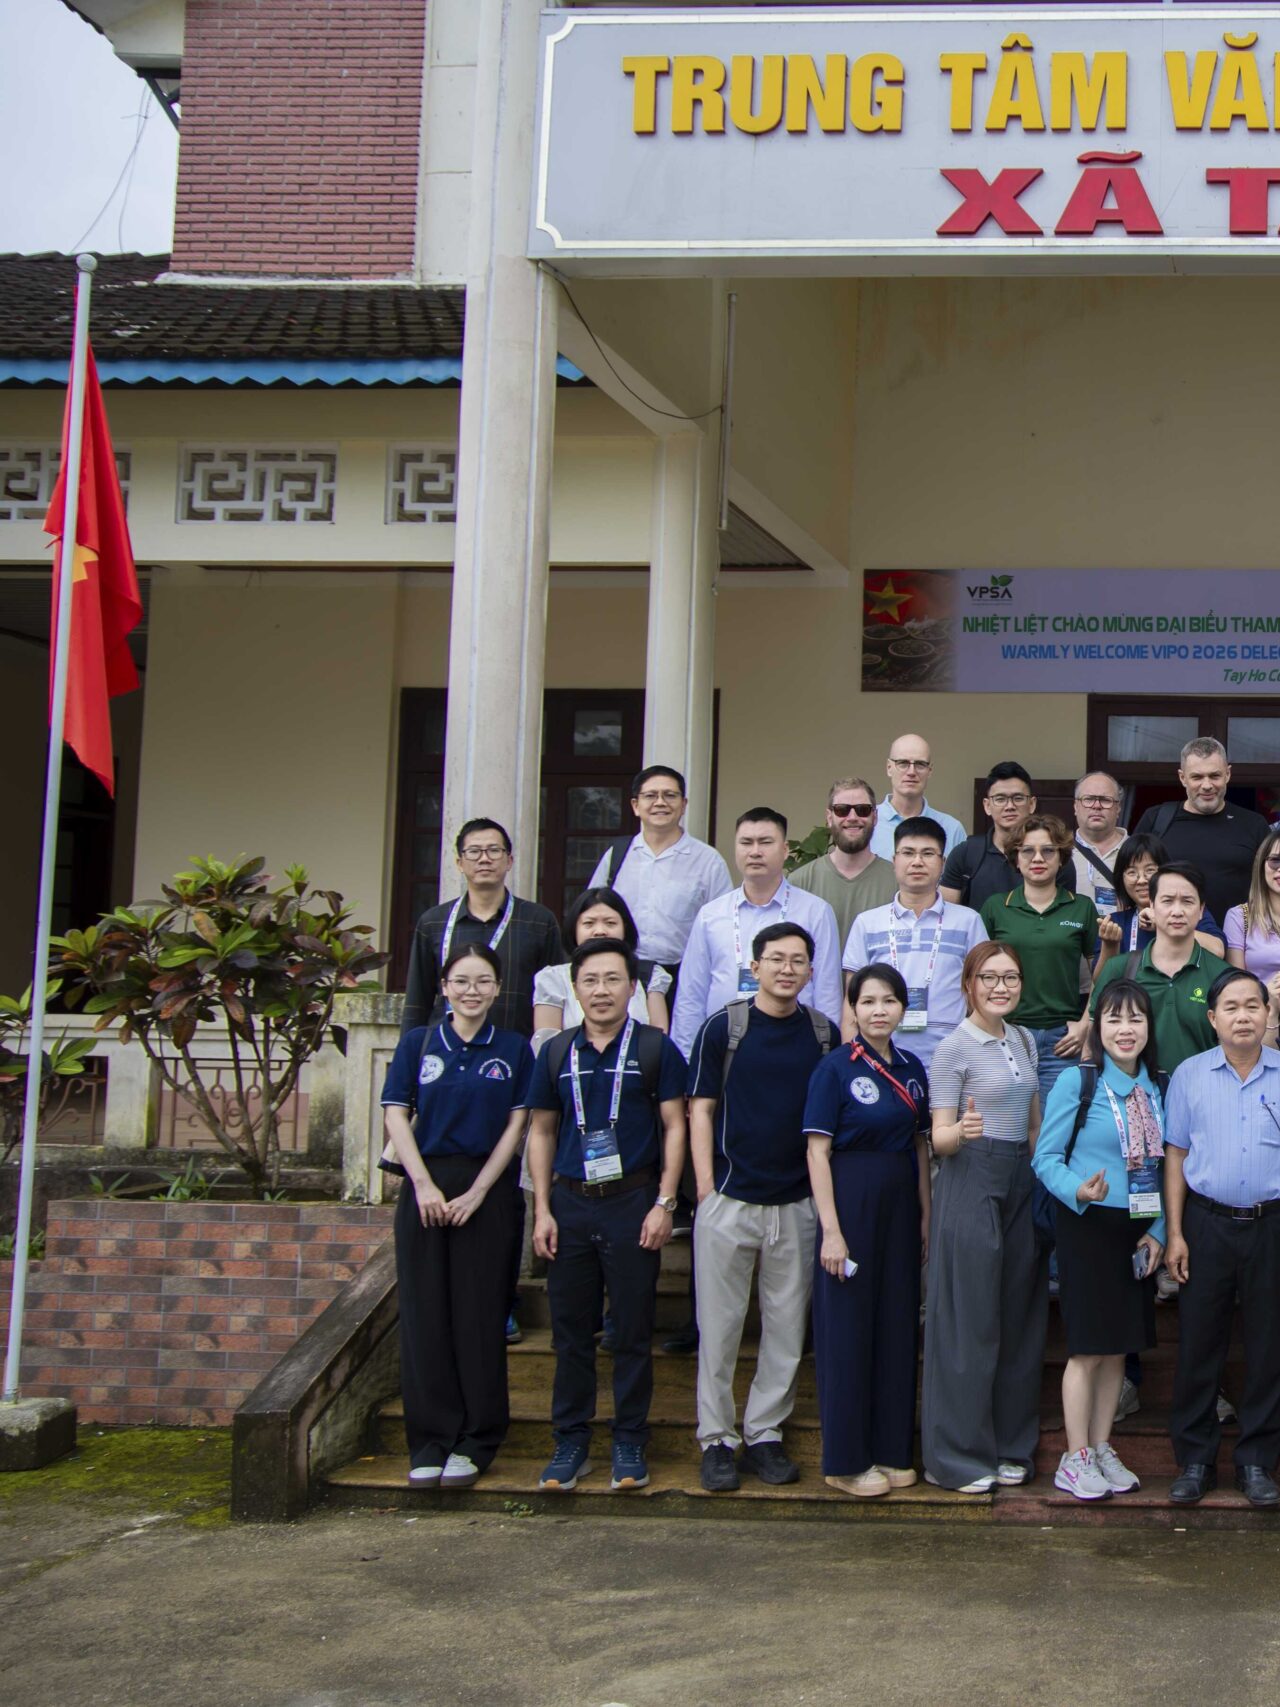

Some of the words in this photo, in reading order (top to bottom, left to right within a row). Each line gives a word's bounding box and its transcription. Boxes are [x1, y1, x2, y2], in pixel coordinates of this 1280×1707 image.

[622, 52, 905, 136] TRUNG
[939, 32, 1130, 134] TÂM
[936, 150, 1165, 236] XÃ
[967, 586, 1013, 599] VPSA
[962, 613, 1011, 636] NHIỆT
[1014, 613, 1049, 636] LIỆT
[1052, 612, 1100, 633] CHÀO
[1156, 615, 1186, 637] ĐẠI
[1189, 609, 1228, 633] BIỂU
[1001, 644, 1071, 661] WARMLY
[1073, 644, 1149, 661] WELCOME
[1151, 644, 1189, 661] VIPO
[1192, 645, 1238, 661] 2026
[1222, 669, 1245, 684] Tay
[1248, 669, 1266, 682] Ho
